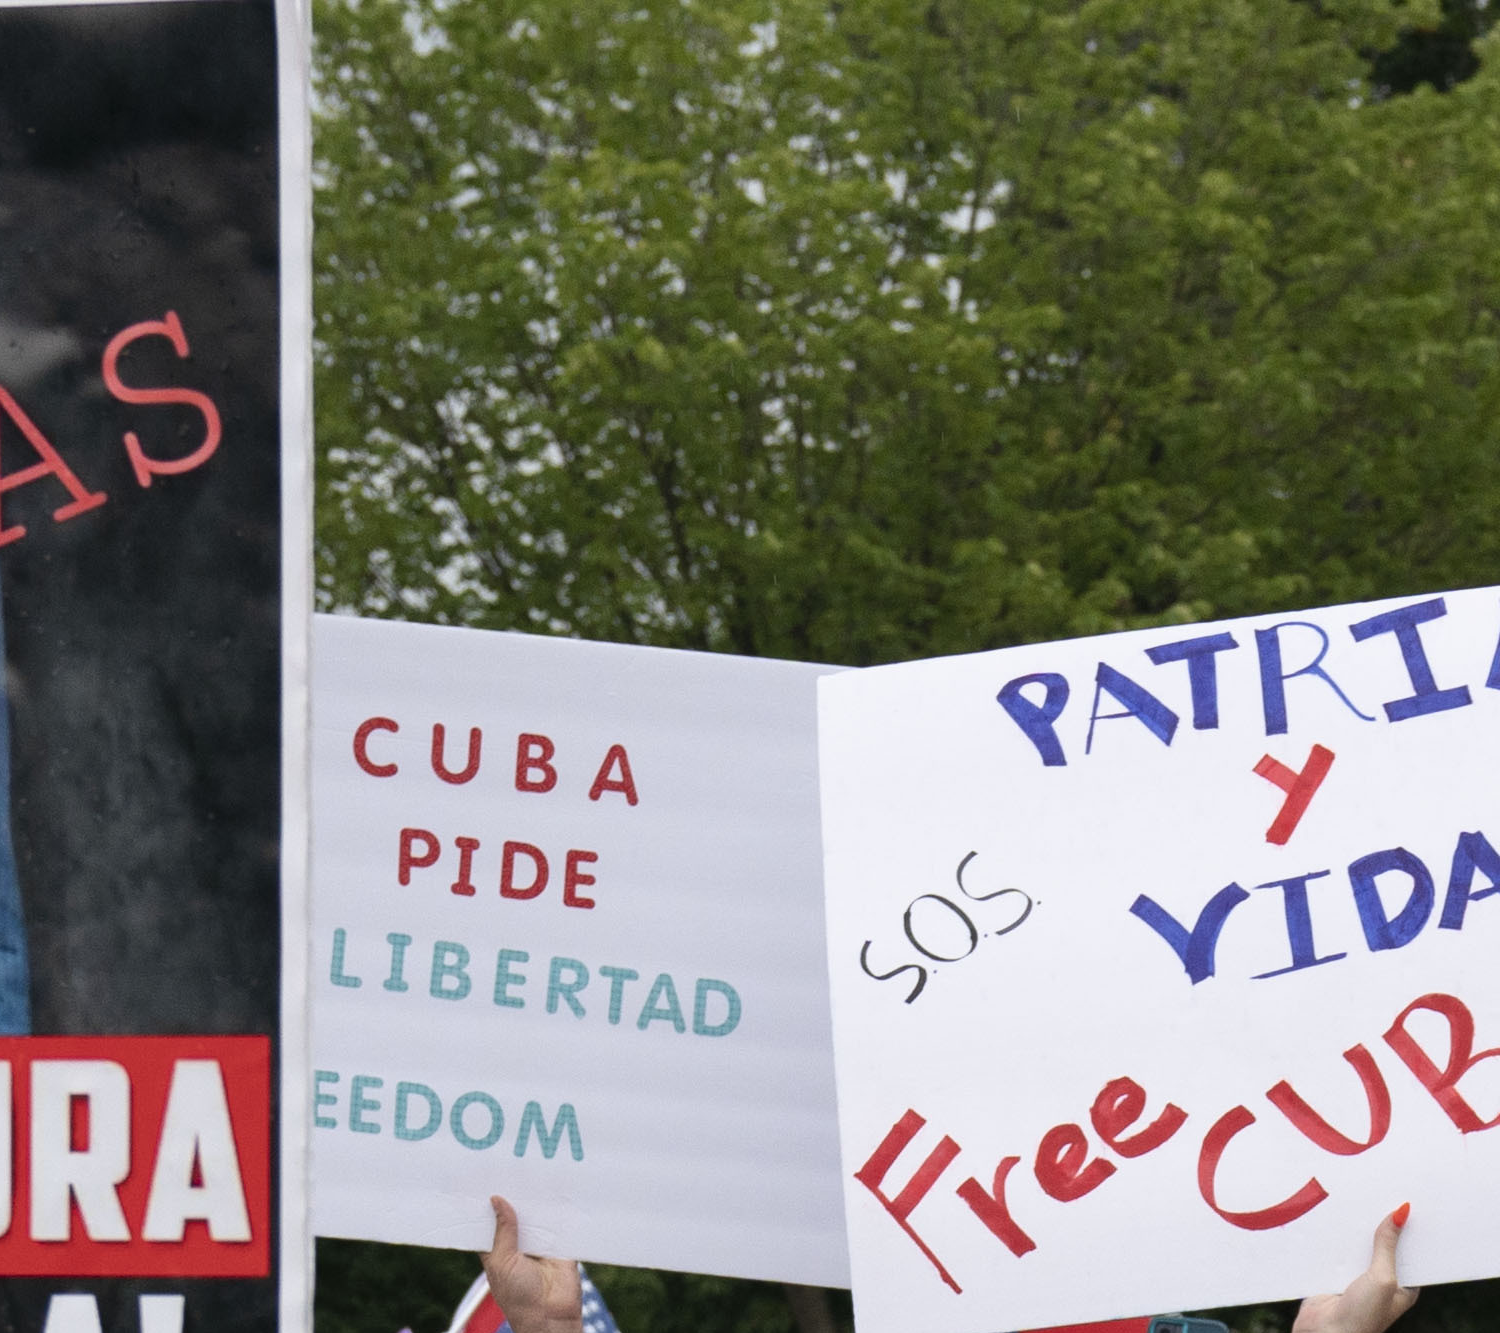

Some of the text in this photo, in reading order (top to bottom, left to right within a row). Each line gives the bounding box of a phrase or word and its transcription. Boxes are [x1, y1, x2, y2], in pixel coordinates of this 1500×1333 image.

[352, 715, 639, 807] CUBA
[1252, 743, 1336, 846] Y
[398, 827, 599, 910] PIDE
[329, 927, 742, 1038] LIBERTAD
[852, 1075, 1190, 1295] Free
